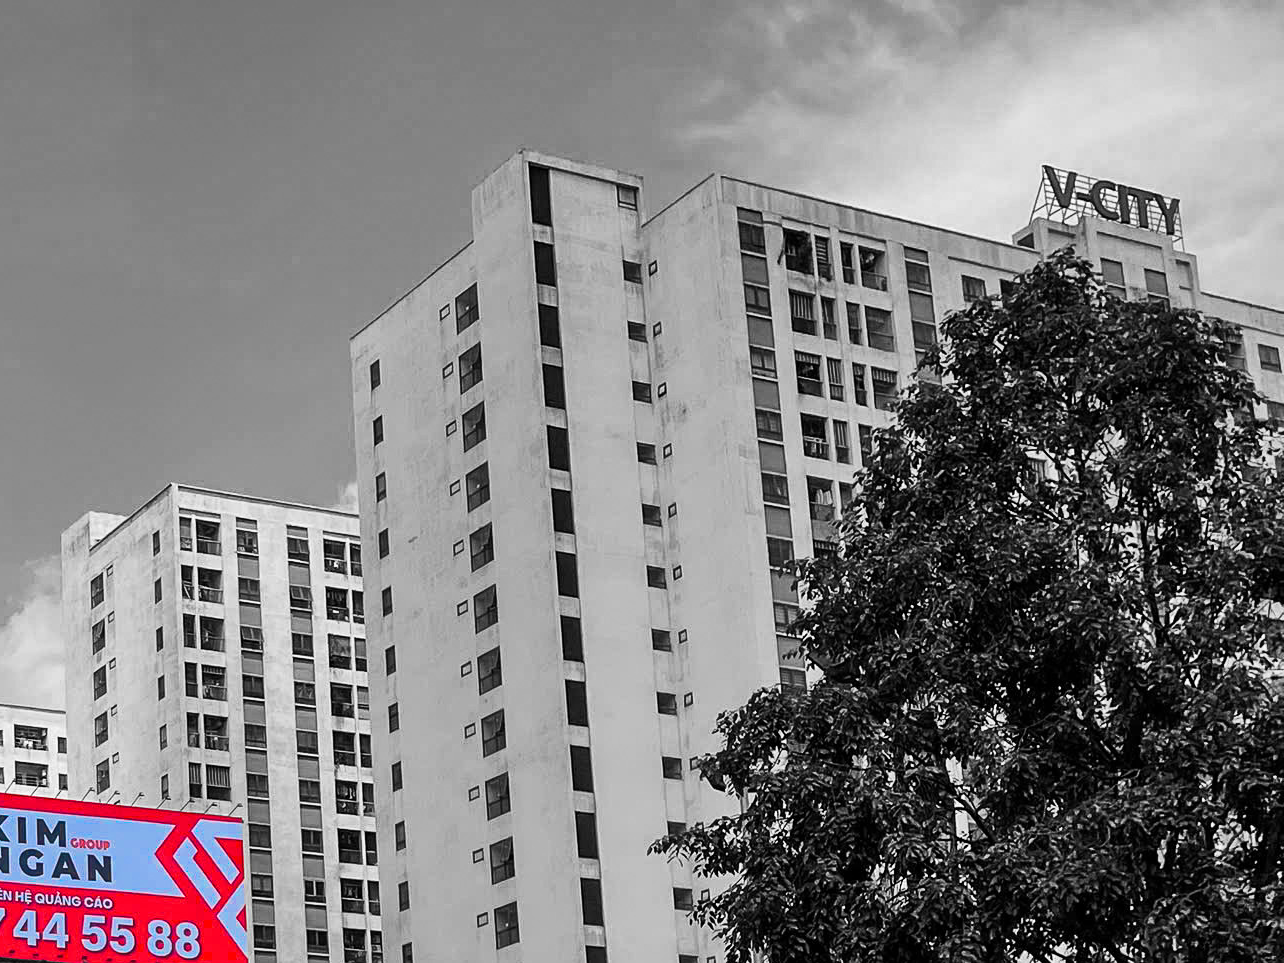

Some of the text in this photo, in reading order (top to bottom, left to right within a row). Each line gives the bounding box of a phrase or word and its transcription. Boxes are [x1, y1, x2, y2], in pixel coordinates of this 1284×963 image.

[1042, 164, 1180, 235] V-CITY
[70, 837, 111, 851] GROUP
[14, 888, 32, 905] HỆ
[34, 890, 82, 908] QUẢNG
[83, 895, 114, 910] CÁO
[12, 909, 69, 949] 44
[81, 914, 136, 954] 55
[146, 919, 201, 959] 88
